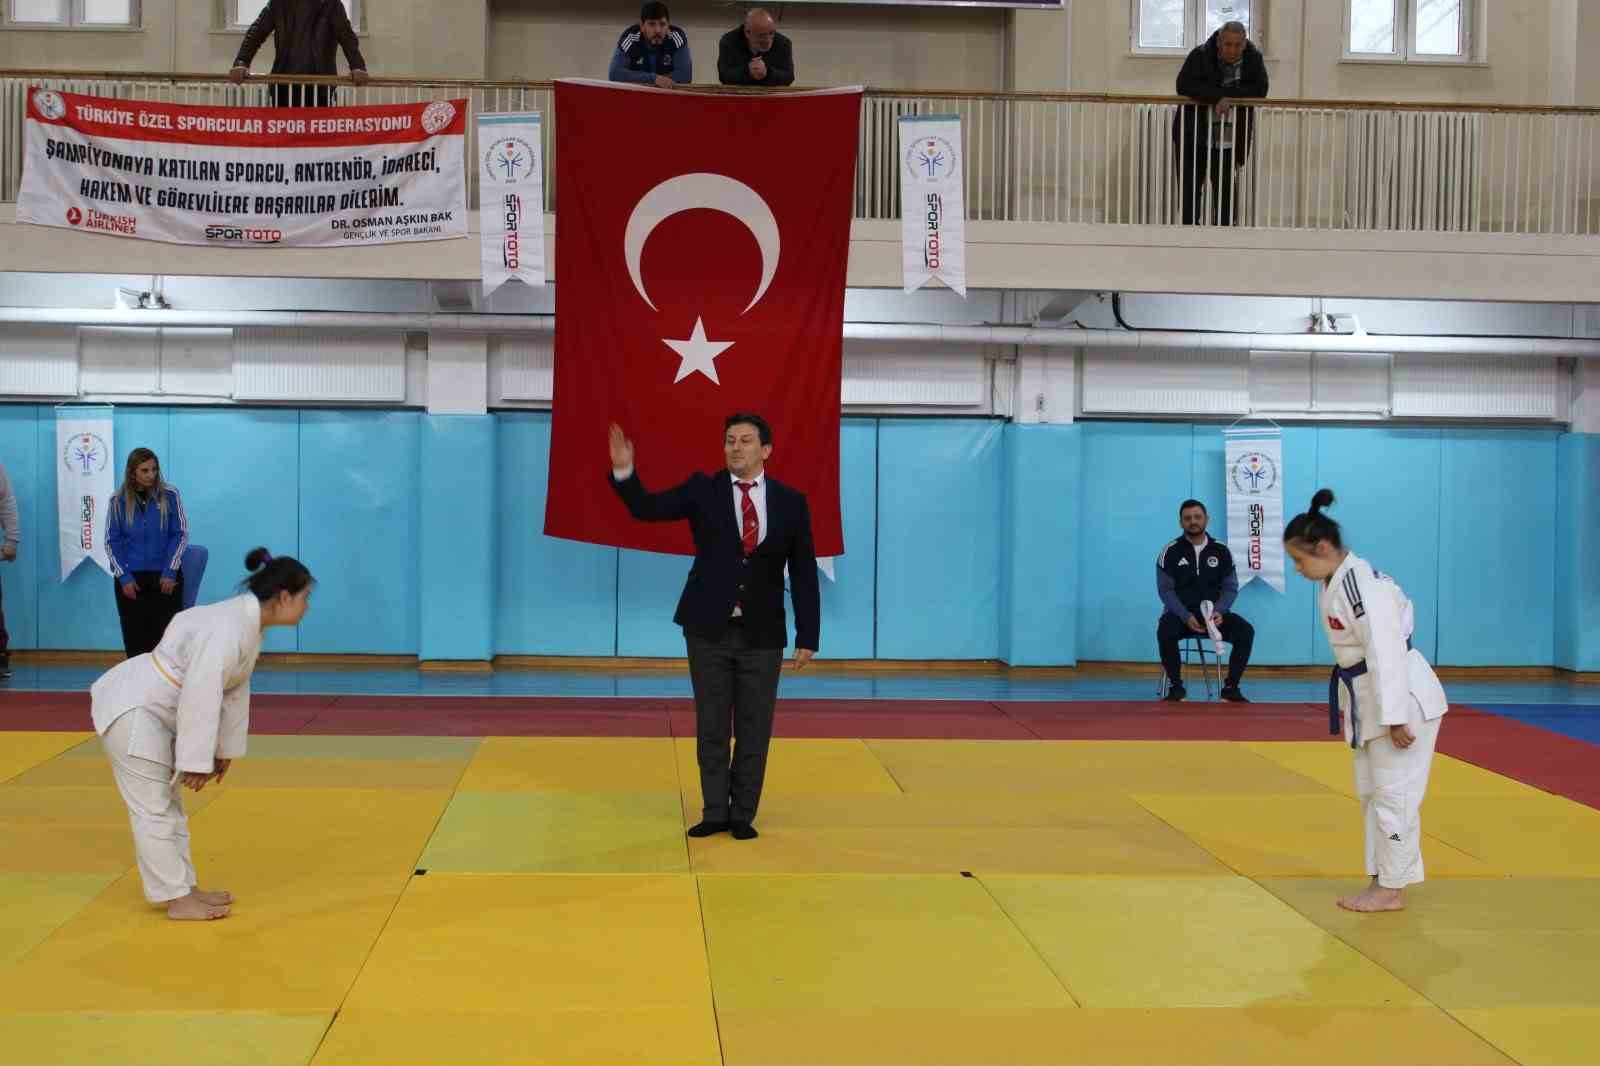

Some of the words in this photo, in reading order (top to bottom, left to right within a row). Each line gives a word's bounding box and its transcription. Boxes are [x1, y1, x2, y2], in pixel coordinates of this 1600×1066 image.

[75, 104, 134, 126] TÜRKİYE
[139, 111, 173, 129] ÖZEL
[177, 115, 262, 134] SPORCULAR
[267, 120, 305, 134] SPOR
[310, 115, 412, 133] FEDERASYONU
[46, 139, 153, 176] ŞAMPİYONAYA
[158, 157, 220, 181] KATILAN
[225, 162, 289, 185] SPORCU,
[294, 156, 377, 183] ANTRENÖR,
[381, 147, 440, 176] İDARECİ,
[80, 178, 132, 203] HAKEM
[135, 184, 153, 206] VE
[157, 187, 250, 214] GÖREVLİLERE
[254, 194, 336, 219] BAŞARILAR
[340, 184, 404, 210] DİLERİM.
[85, 218, 137, 234] AIRLINES
[87, 208, 137, 226] TURKISH
[331, 219, 351, 230] DR.
[352, 214, 393, 227] OSMAN
[395, 213, 428, 226] AŞKIN
[430, 211, 453, 223] BAK
[379, 229, 390, 238] VE
[391, 227, 412, 237] SPOR
